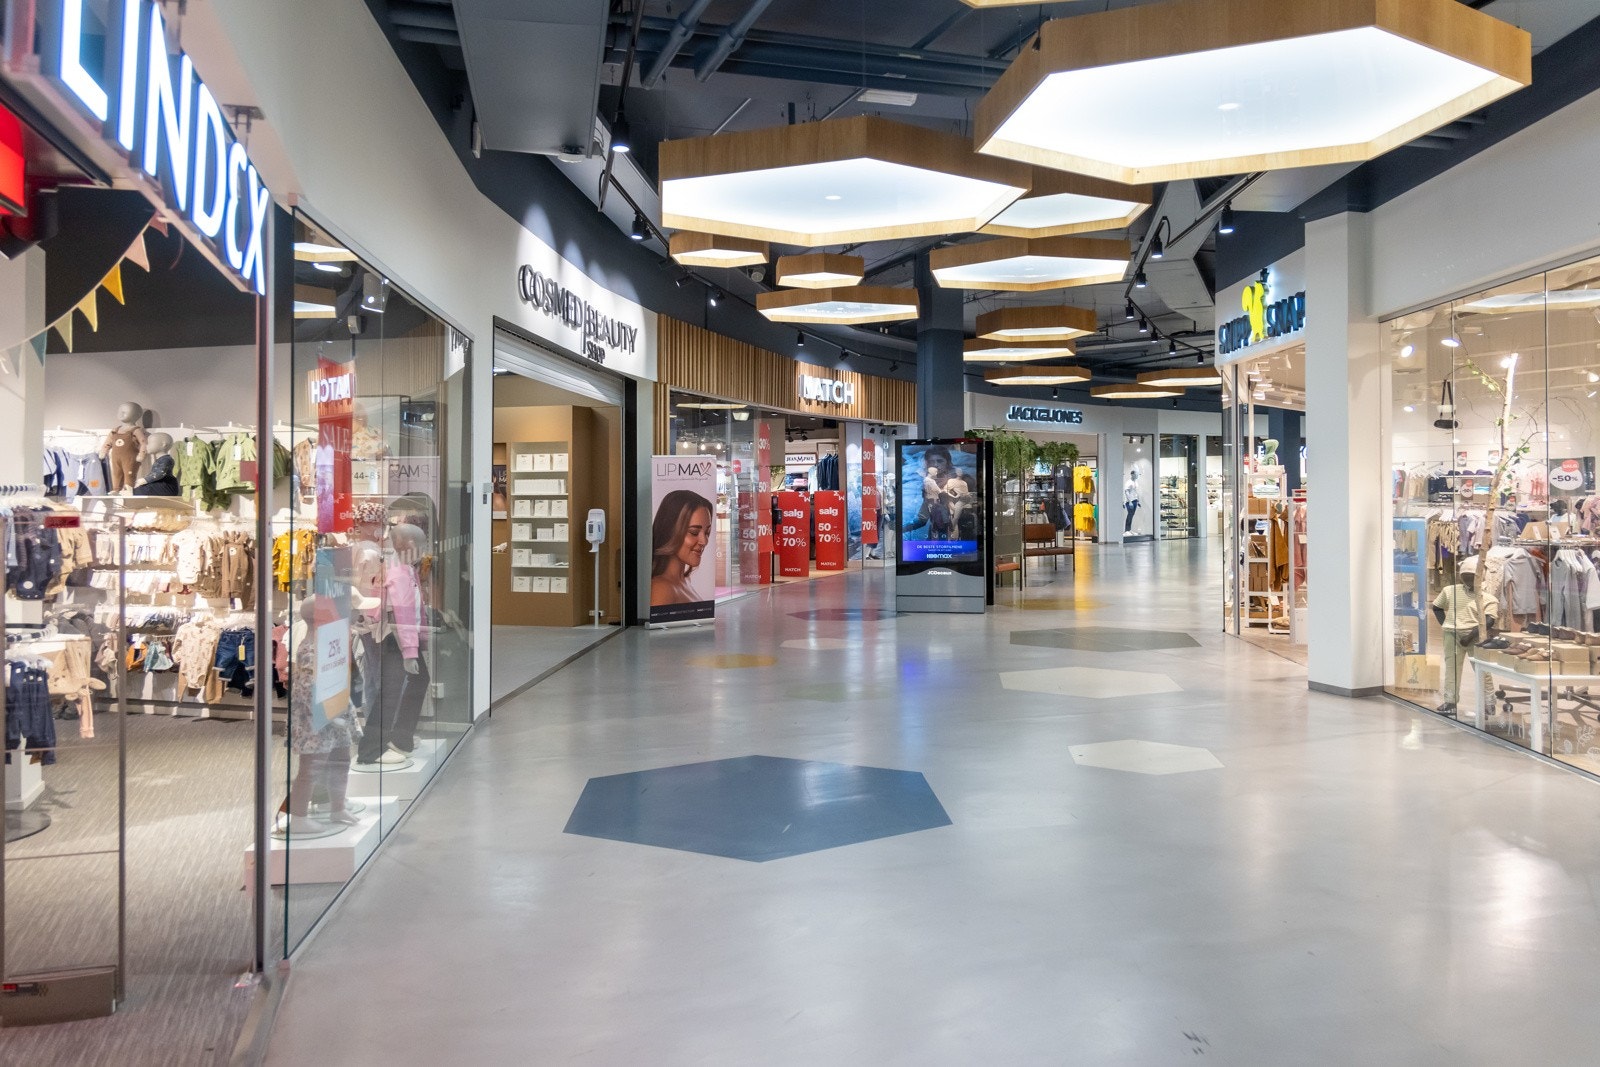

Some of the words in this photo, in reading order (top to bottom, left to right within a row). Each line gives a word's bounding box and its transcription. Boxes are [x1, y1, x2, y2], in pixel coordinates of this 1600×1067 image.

[61, 0, 270, 296] LINDEX
[518, 264, 582, 330] COSMED
[585, 304, 638, 354] BEAUTY
[587, 341, 606, 363] SHOP
[799, 374, 855, 404] MATCH
[783, 509, 804, 519] salg
[819, 507, 839, 517] salg
[758, 525, 772, 537] 70%
[783, 538, 807, 547] 70%
[819, 534, 842, 543] 70%
